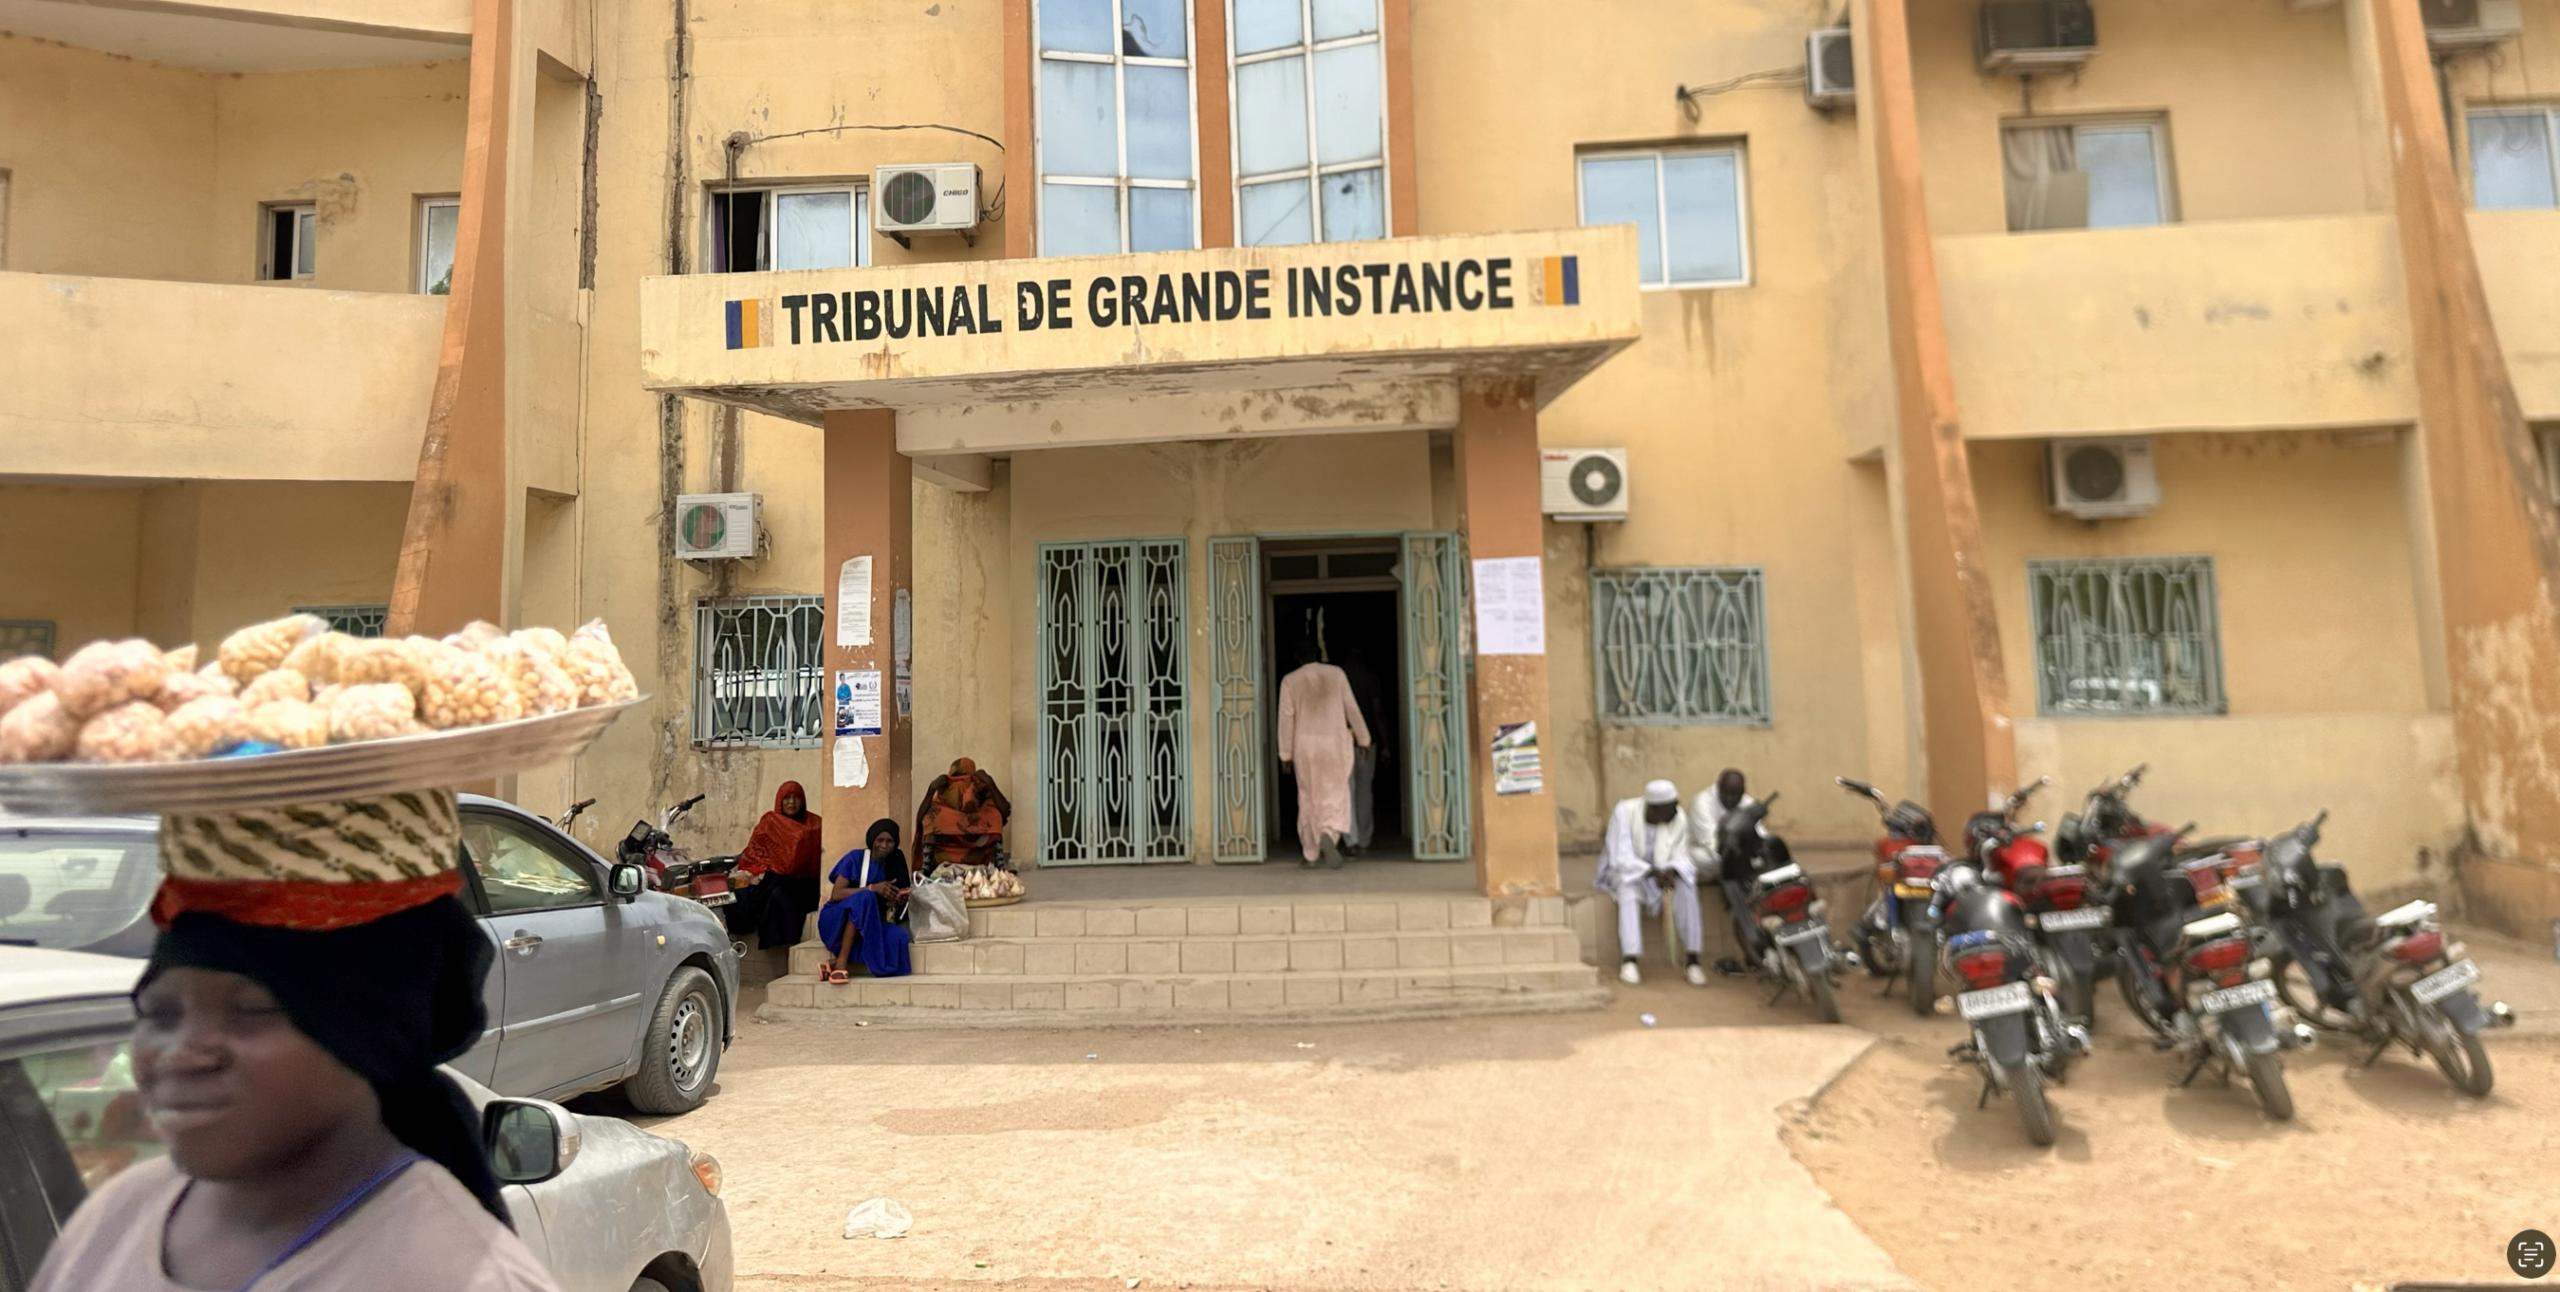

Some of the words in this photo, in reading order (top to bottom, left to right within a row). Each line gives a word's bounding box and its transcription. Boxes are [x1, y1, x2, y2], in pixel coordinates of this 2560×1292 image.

[781, 284, 1002, 345] TRIBUNAL
[1017, 279, 1073, 333] DE
[1088, 269, 1271, 328] GRANDE
[1287, 258, 1513, 318] INSTANCE
